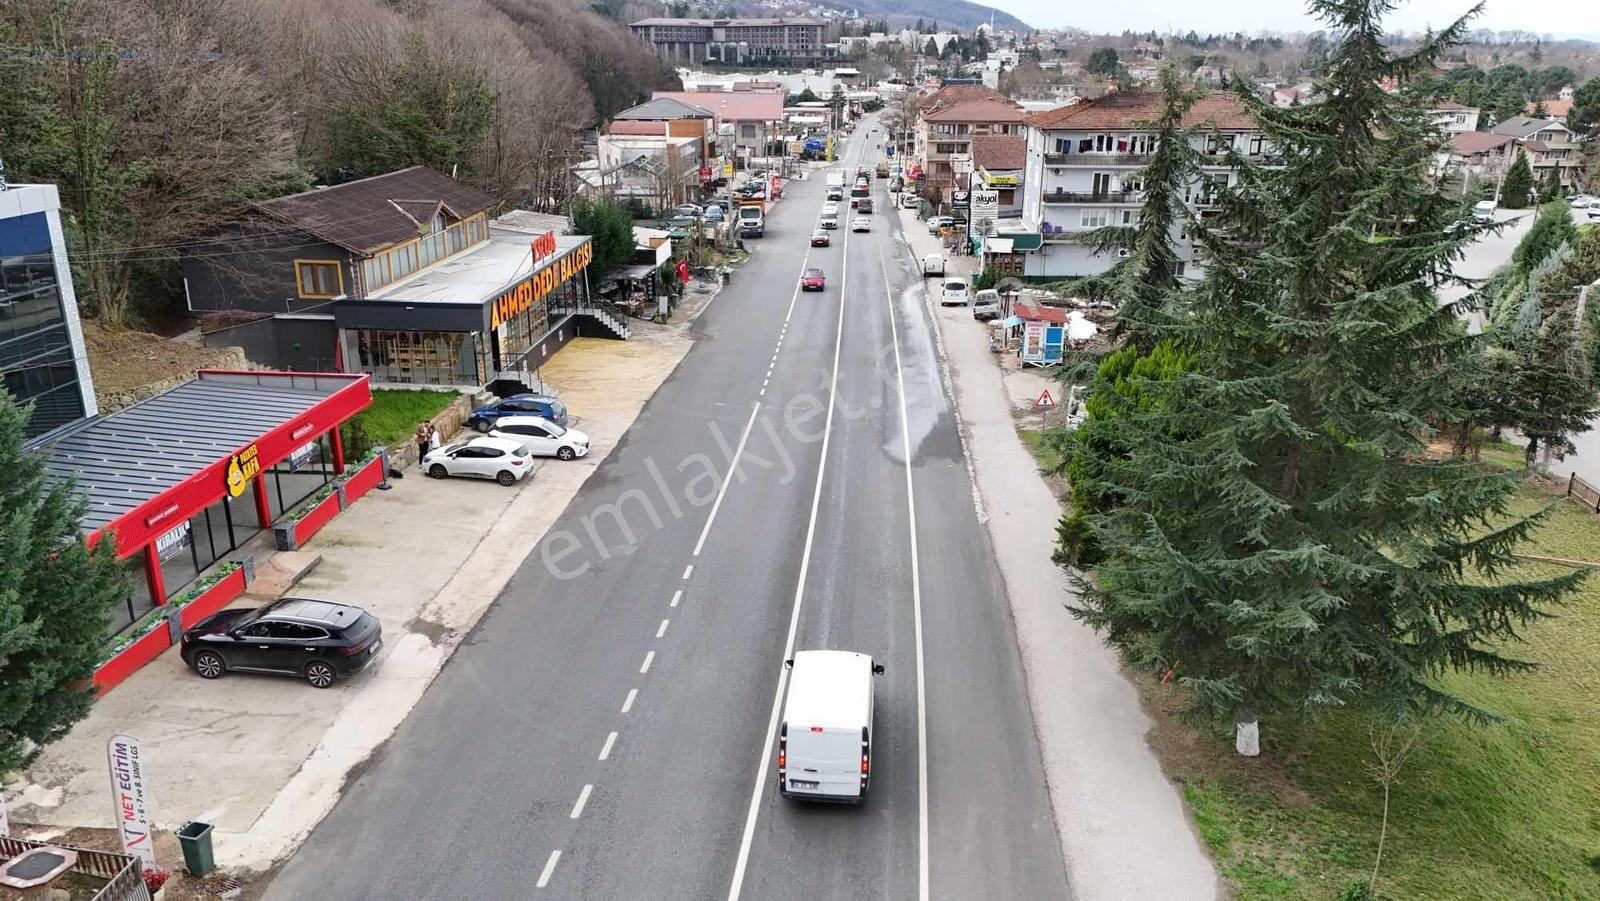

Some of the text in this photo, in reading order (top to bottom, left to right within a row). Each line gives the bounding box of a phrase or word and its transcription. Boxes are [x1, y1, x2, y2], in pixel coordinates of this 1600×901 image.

[976, 194, 998, 205] akyol
[491, 281, 532, 331] AHMED
[533, 262, 560, 300] DEDE
[130, 745, 139, 760] LGS
[113, 743, 135, 821] NET EĞİTİM
